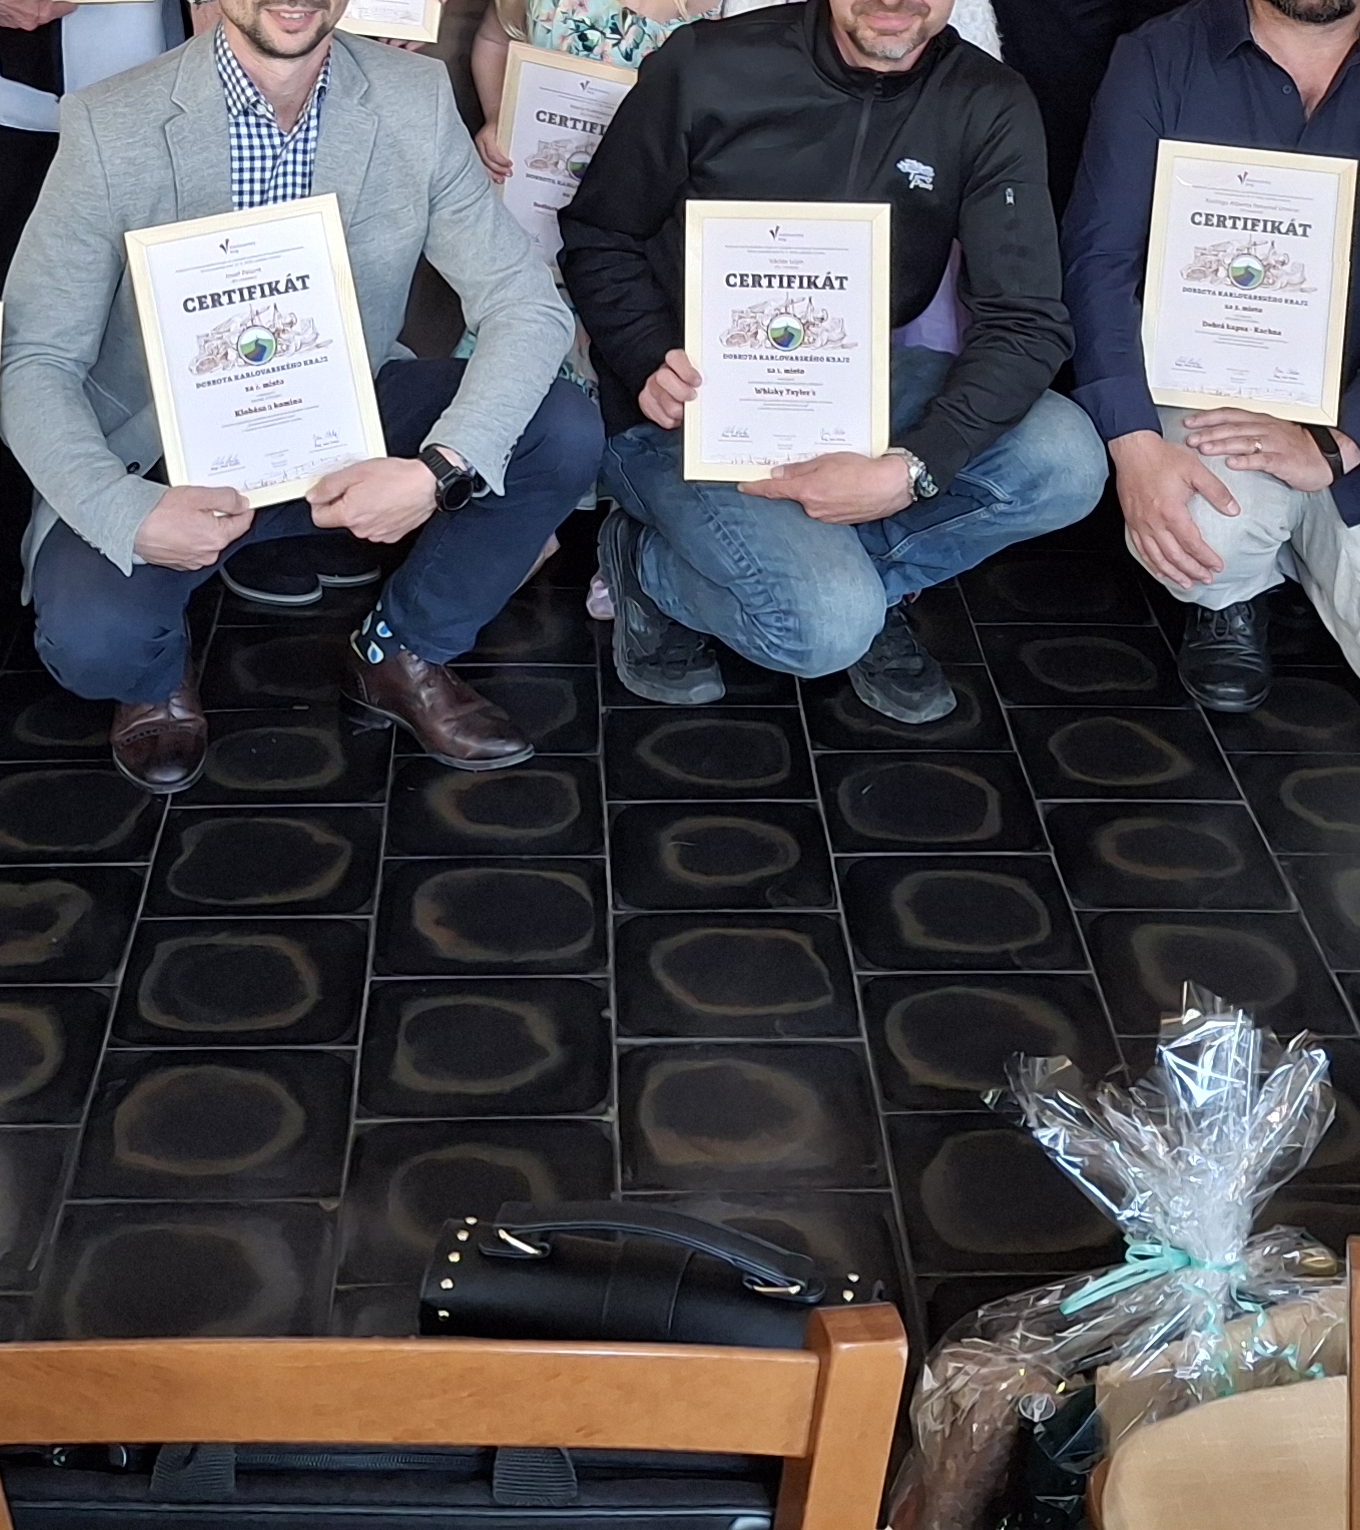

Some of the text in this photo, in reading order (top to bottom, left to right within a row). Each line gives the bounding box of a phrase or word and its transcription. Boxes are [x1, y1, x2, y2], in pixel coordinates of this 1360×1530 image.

[536, 110, 608, 136] CERTIFI
[1190, 212, 1312, 238] CERTIFIKÁT
[182, 274, 310, 313] CERTIFIKÁT
[725, 272, 848, 290] CERTIFIKÁT
[1254, 326, 1282, 336] Kachna
